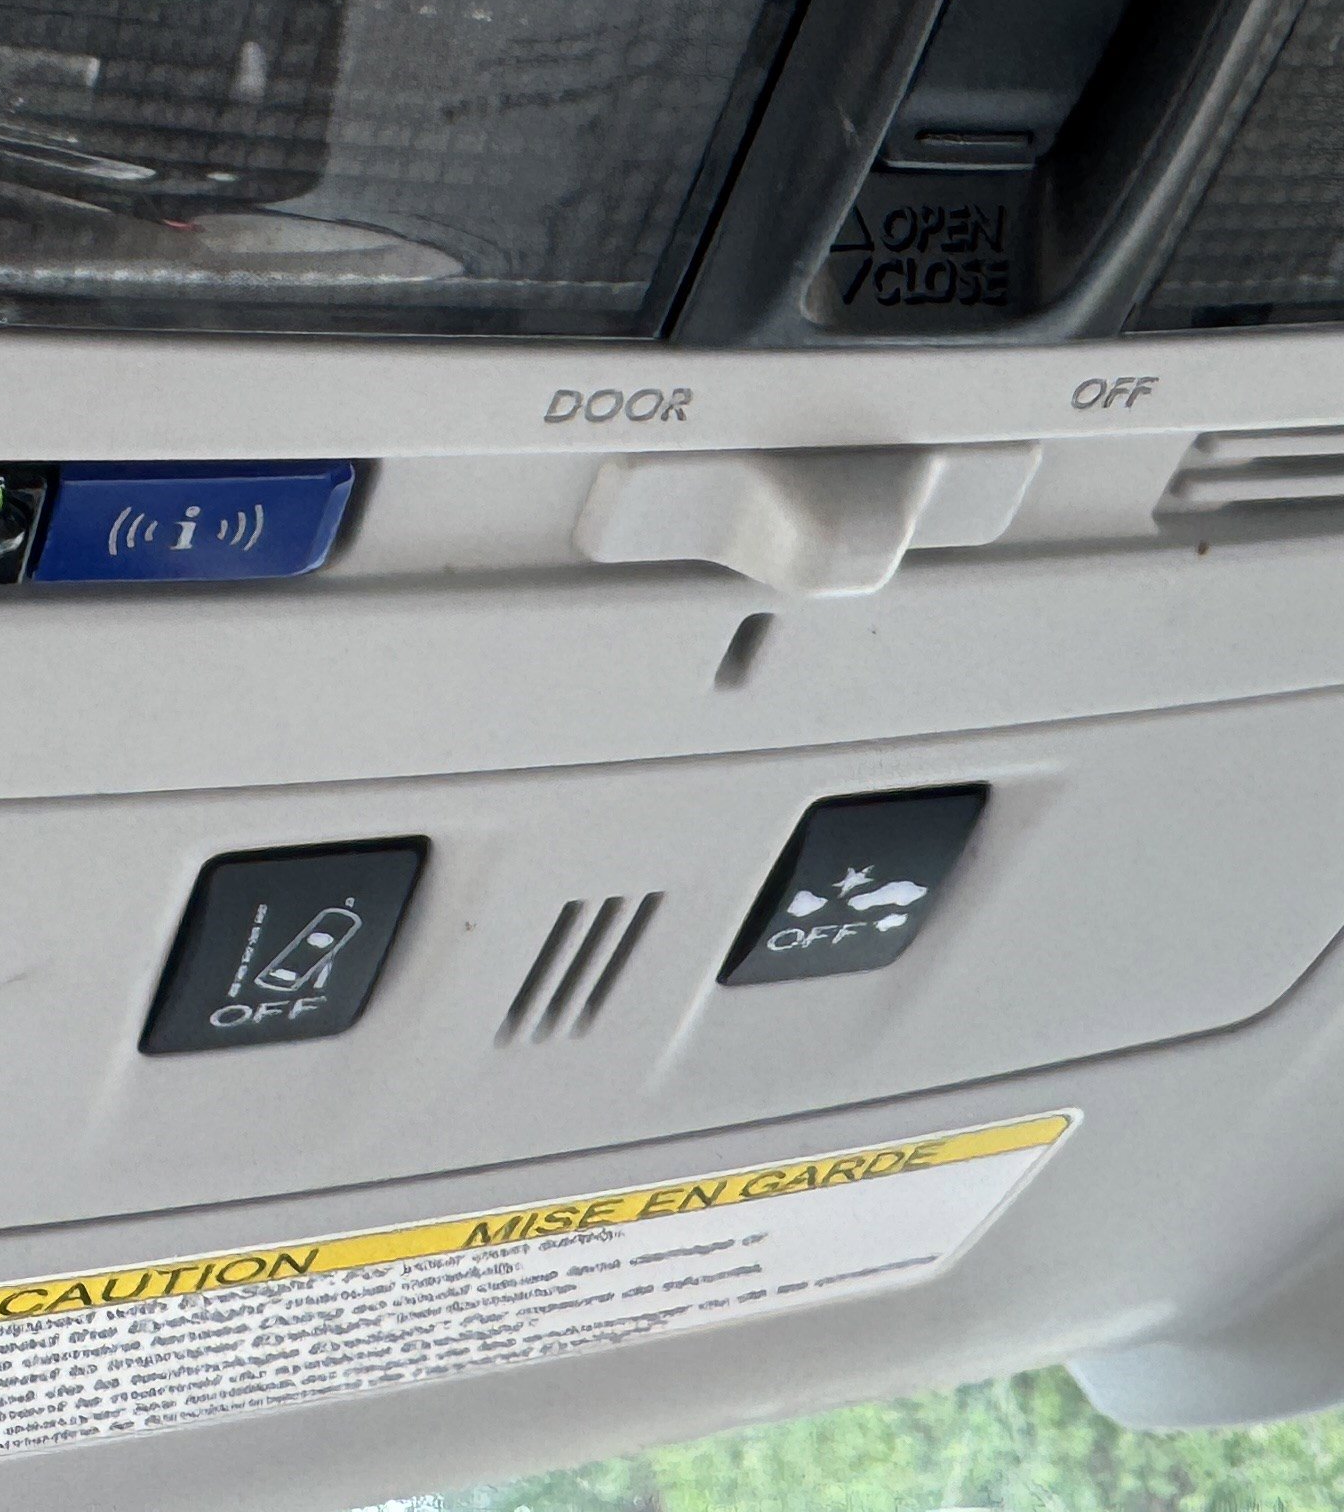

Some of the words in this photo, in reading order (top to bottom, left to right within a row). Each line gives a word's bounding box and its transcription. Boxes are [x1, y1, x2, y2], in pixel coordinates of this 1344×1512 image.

[882, 204, 1006, 254] OPEN
[543, 387, 694, 423] DOOR
[1070, 376, 1160, 410] OFF
[767, 922, 864, 954] OFF
[210, 996, 327, 1028] OFF
[467, 1197, 623, 1247] MISE
[637, 1182, 726, 1218] EN
[739, 1140, 947, 1200] GARDE
